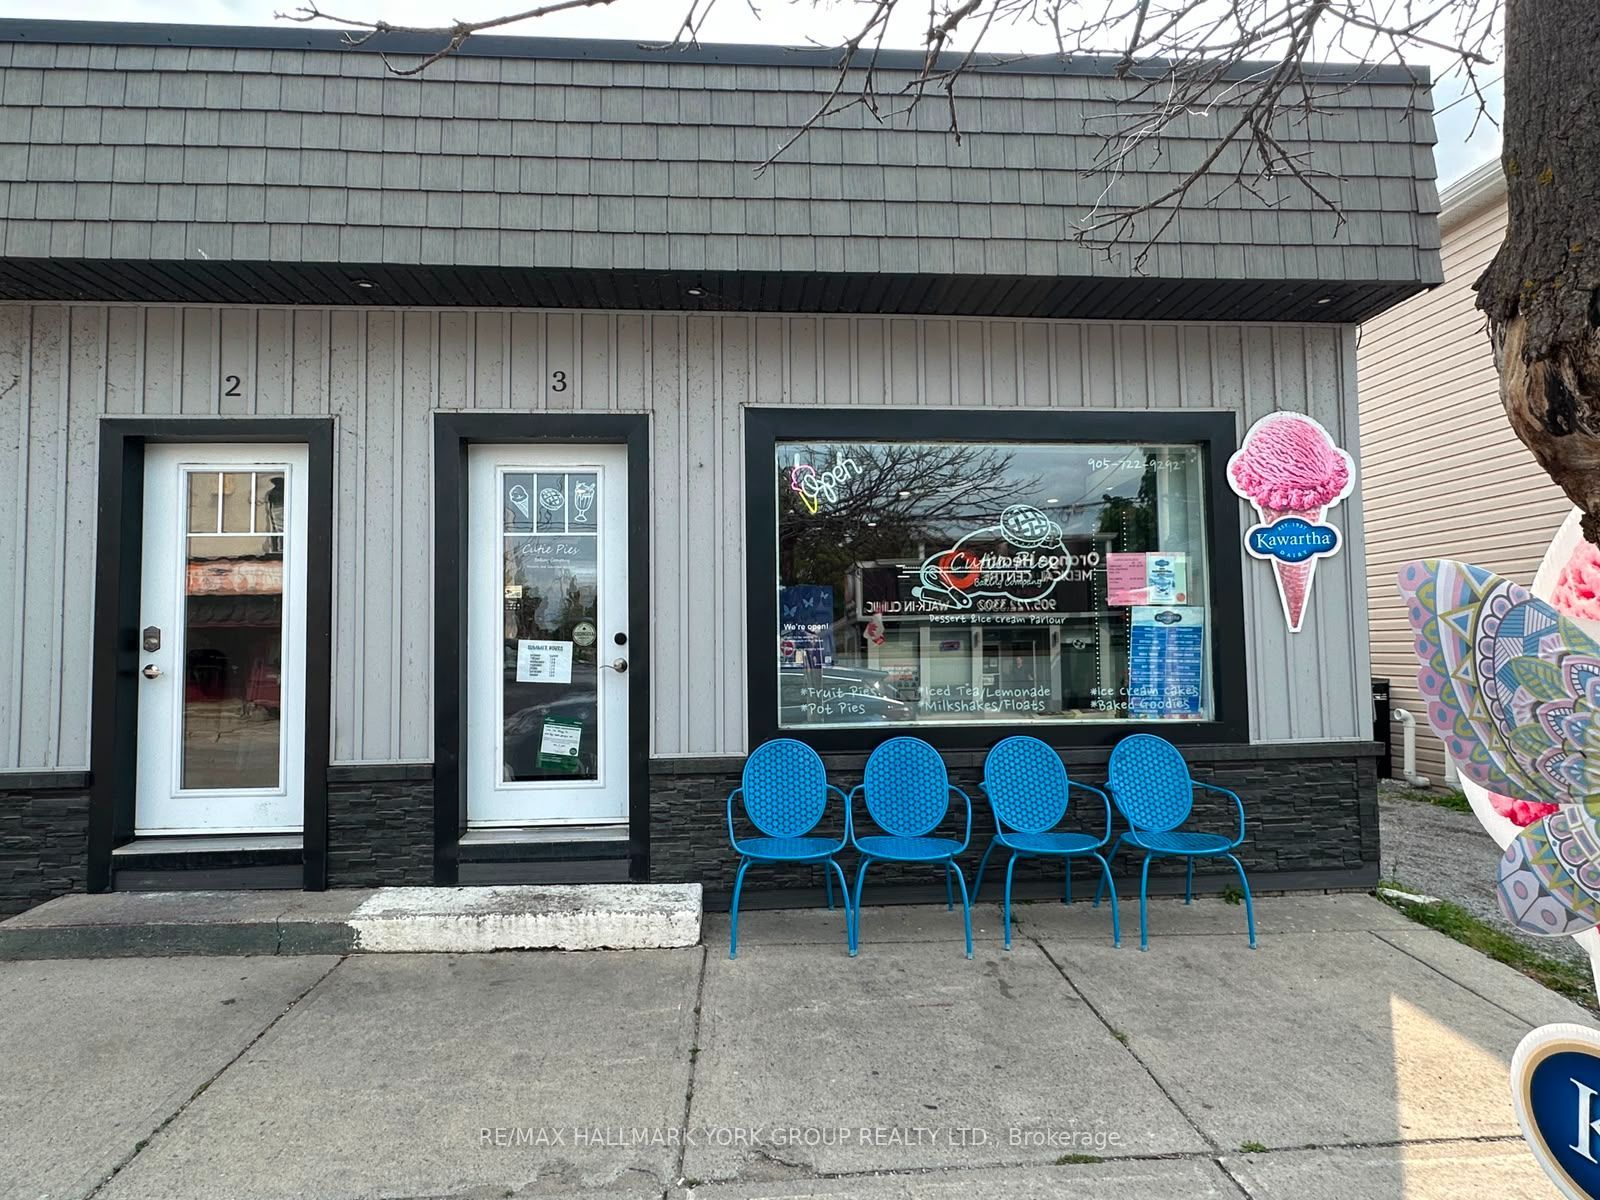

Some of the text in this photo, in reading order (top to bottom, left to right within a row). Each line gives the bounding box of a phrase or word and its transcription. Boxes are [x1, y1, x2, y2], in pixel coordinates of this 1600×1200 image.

[224, 375, 242, 397] 2
[551, 371, 567, 392] 3
[1087, 457, 1181, 473] 905-722-9292
[802, 458, 863, 503] Open
[1255, 531, 1331, 549] Kawartha
[522, 543, 580, 555] Cutie Pies
[1280, 549, 1308, 558] DAIRY
[929, 613, 967, 624] Dessert
[995, 613, 1027, 623] cream
[1028, 613, 1067, 625] Parlour
[783, 622, 829, 632] We're open!
[956, 683, 1052, 699] Tea/Lemonade
[838, 701, 867, 715] Pies
[1139, 698, 1191, 710] Goodies
